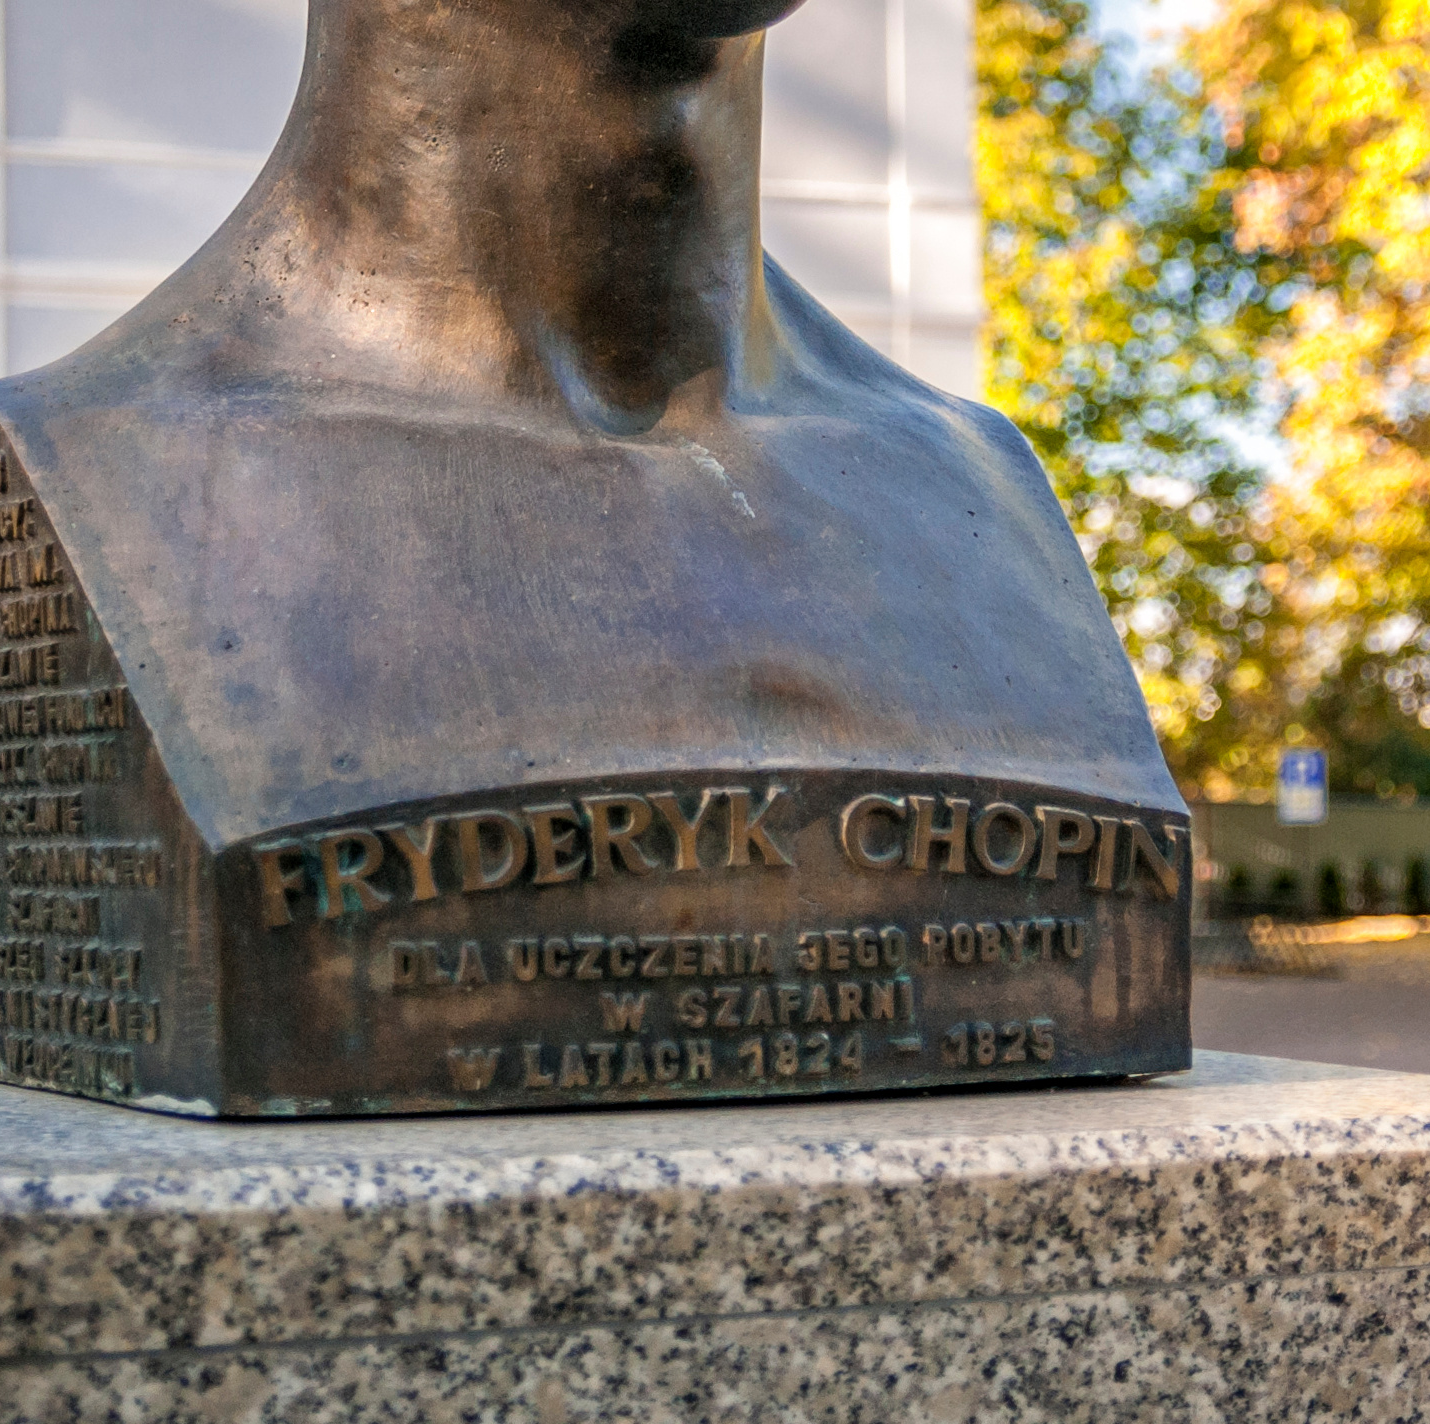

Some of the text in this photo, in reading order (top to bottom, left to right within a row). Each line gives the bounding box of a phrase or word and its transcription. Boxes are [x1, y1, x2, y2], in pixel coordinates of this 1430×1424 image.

[253, 785, 1192, 928] FRYDERYK CHOPIN
[389, 916, 1086, 987] DLA UCZCZENIA JEGO POBYTU
[599, 975, 914, 1032] W SZAFARNI
[447, 1047, 502, 1091] W
[521, 1039, 713, 1088] LATACH
[737, 1030, 864, 1077] 1824
[939, 1017, 1057, 1068] 1825
